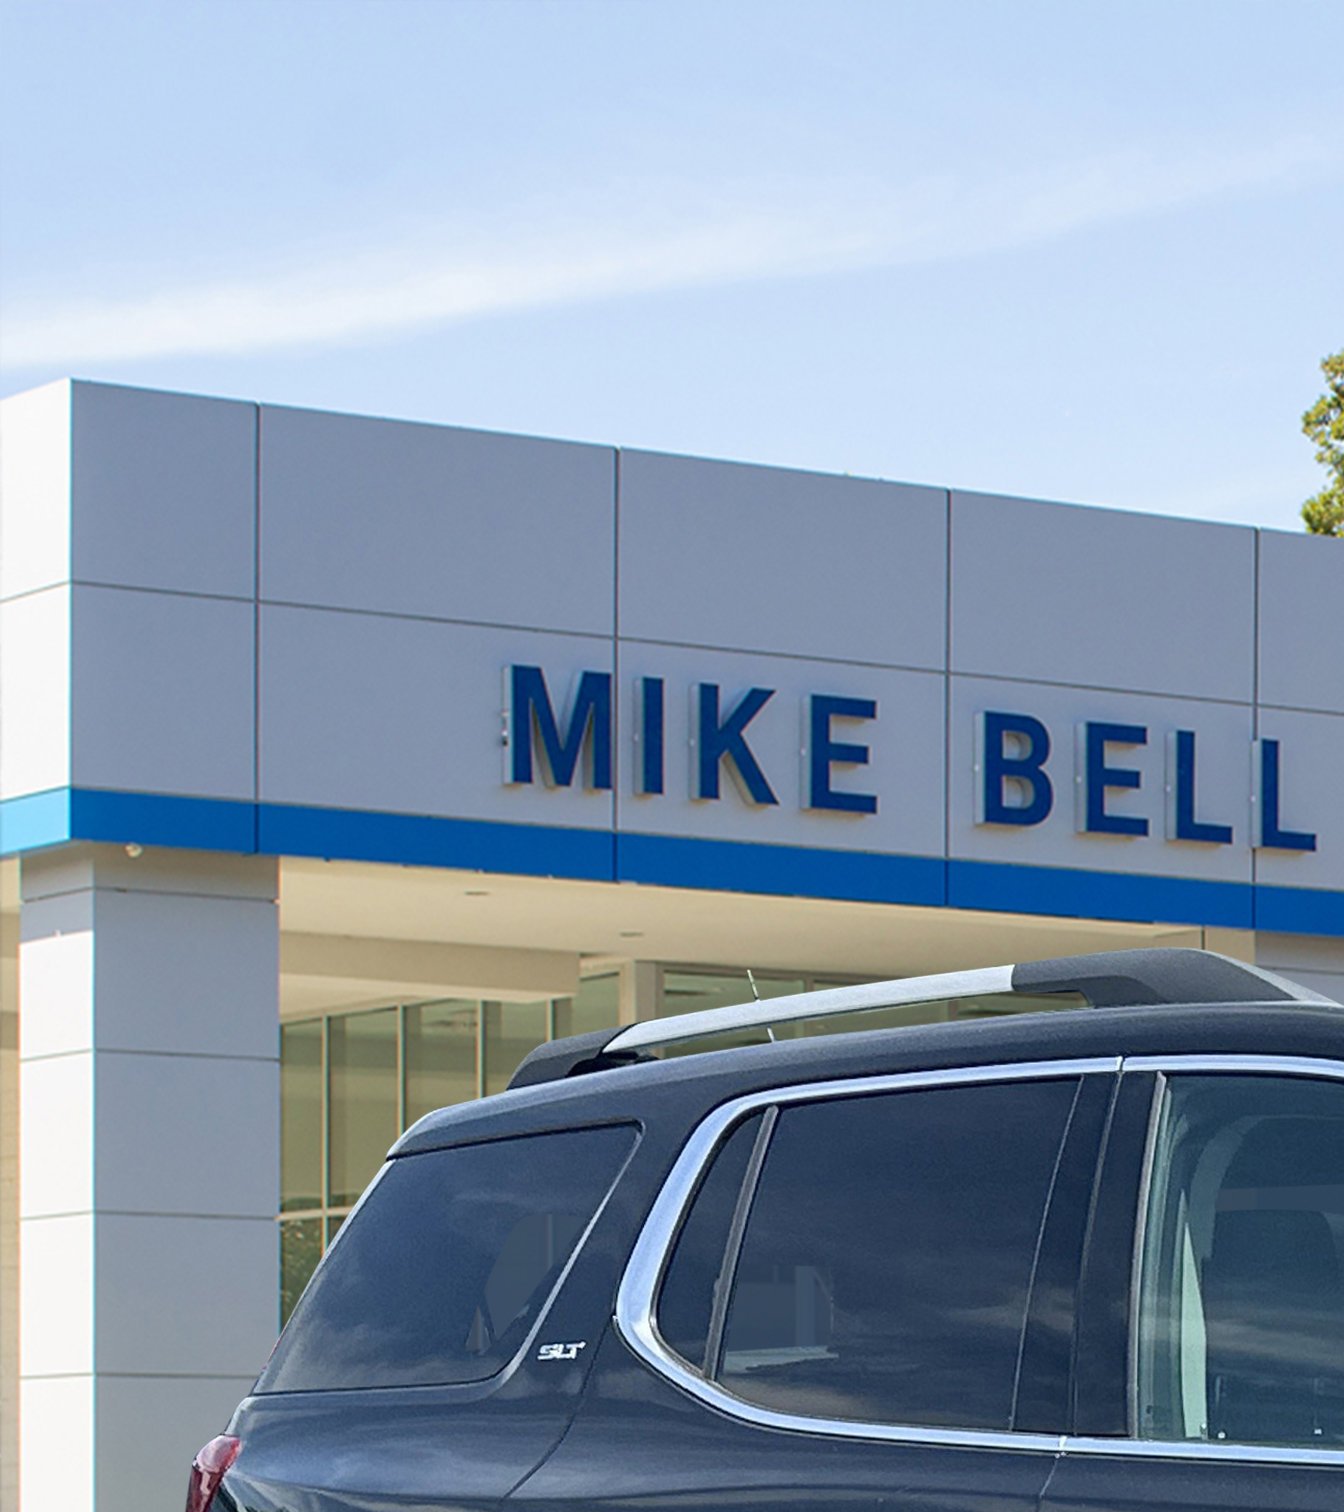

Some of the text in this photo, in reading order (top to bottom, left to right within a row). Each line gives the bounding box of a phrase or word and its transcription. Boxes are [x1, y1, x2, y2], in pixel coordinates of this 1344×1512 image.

[502, 664, 1318, 853] MIKE BELL
[537, 1341, 587, 1361] SLT
